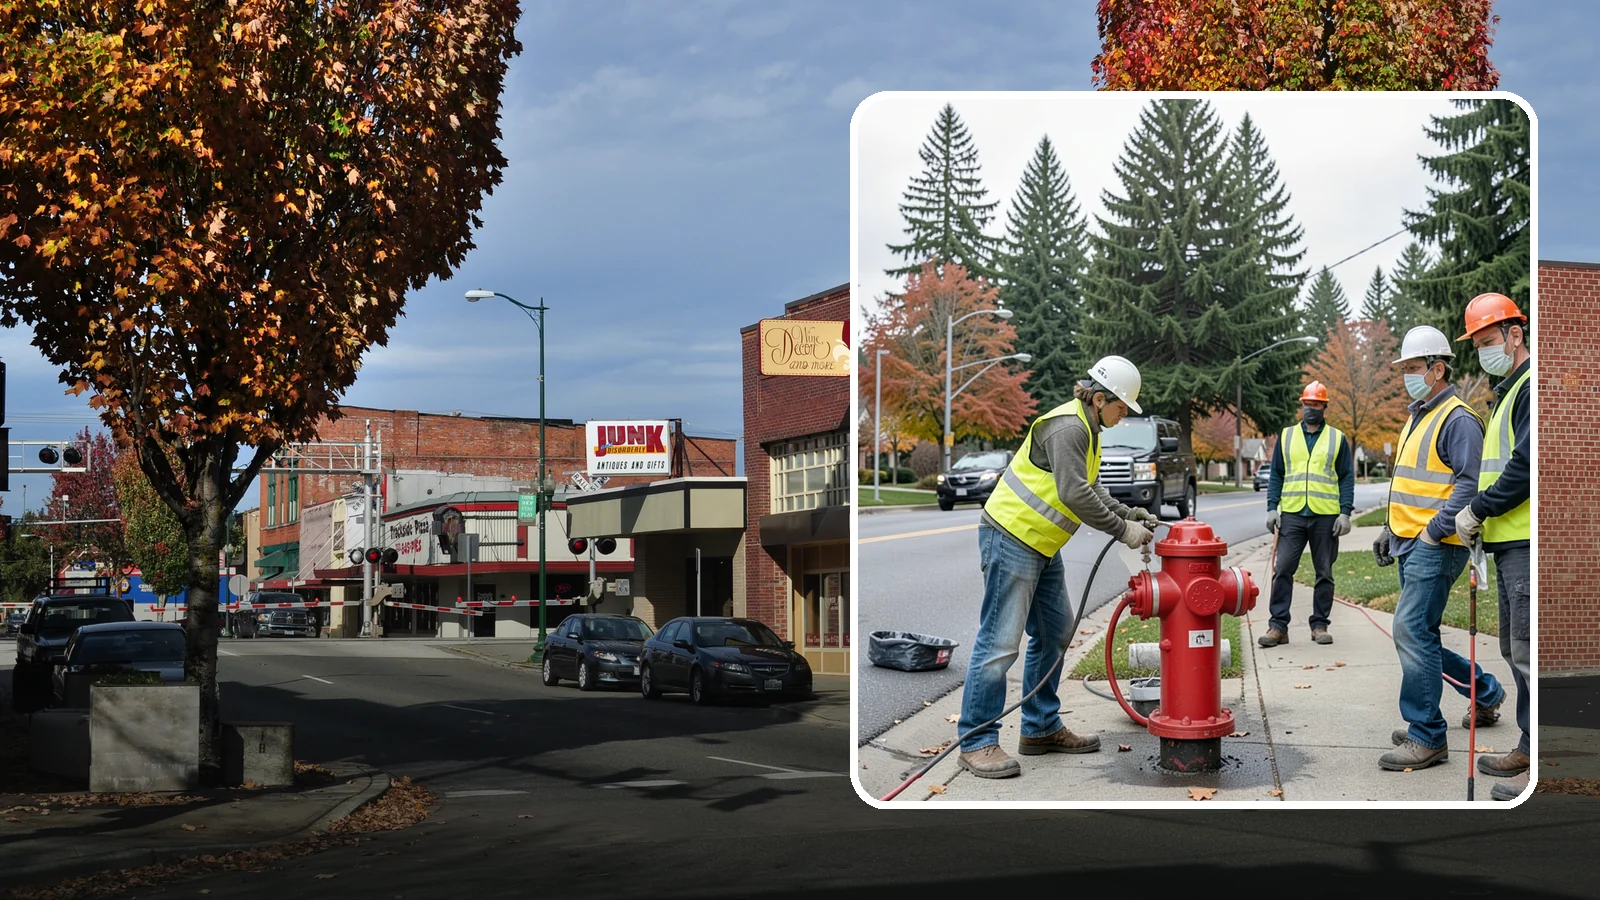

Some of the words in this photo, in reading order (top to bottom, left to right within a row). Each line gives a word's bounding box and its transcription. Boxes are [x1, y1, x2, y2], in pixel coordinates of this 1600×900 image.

[595, 425, 665, 457] JUNK
[607, 446, 645, 454] DISORDERLY
[597, 461, 628, 470] ANTIQUES
[631, 461, 644, 469] AND
[647, 460, 665, 469] GIFTS
[390, 520, 413, 540] Trackside
[414, 519, 429, 535] Pizza
